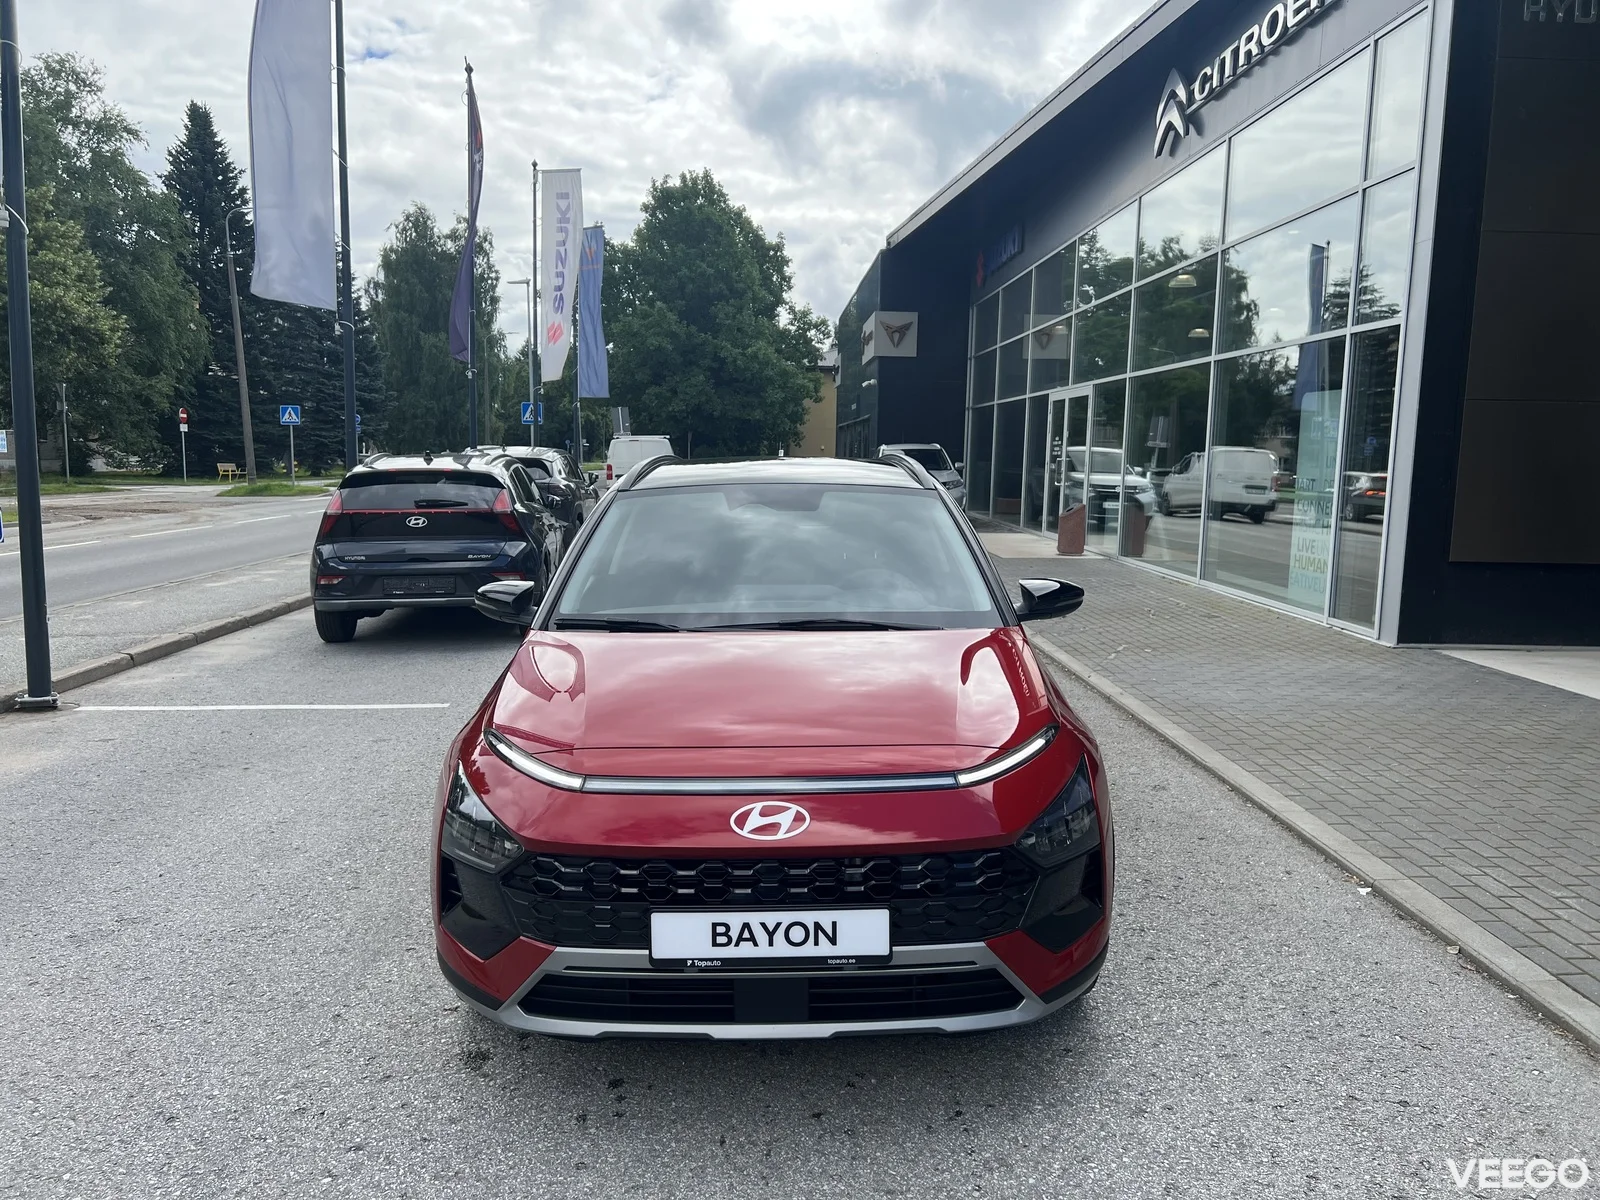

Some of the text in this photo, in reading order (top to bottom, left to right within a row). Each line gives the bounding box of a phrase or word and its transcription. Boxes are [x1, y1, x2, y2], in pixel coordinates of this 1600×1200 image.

[1193, 0, 1326, 101] CITROE
[553, 191, 571, 315] SUZUKI
[1293, 553, 1328, 574] HUMAN
[711, 921, 838, 948] BAYON
[694, 959, 721, 967] Topauto
